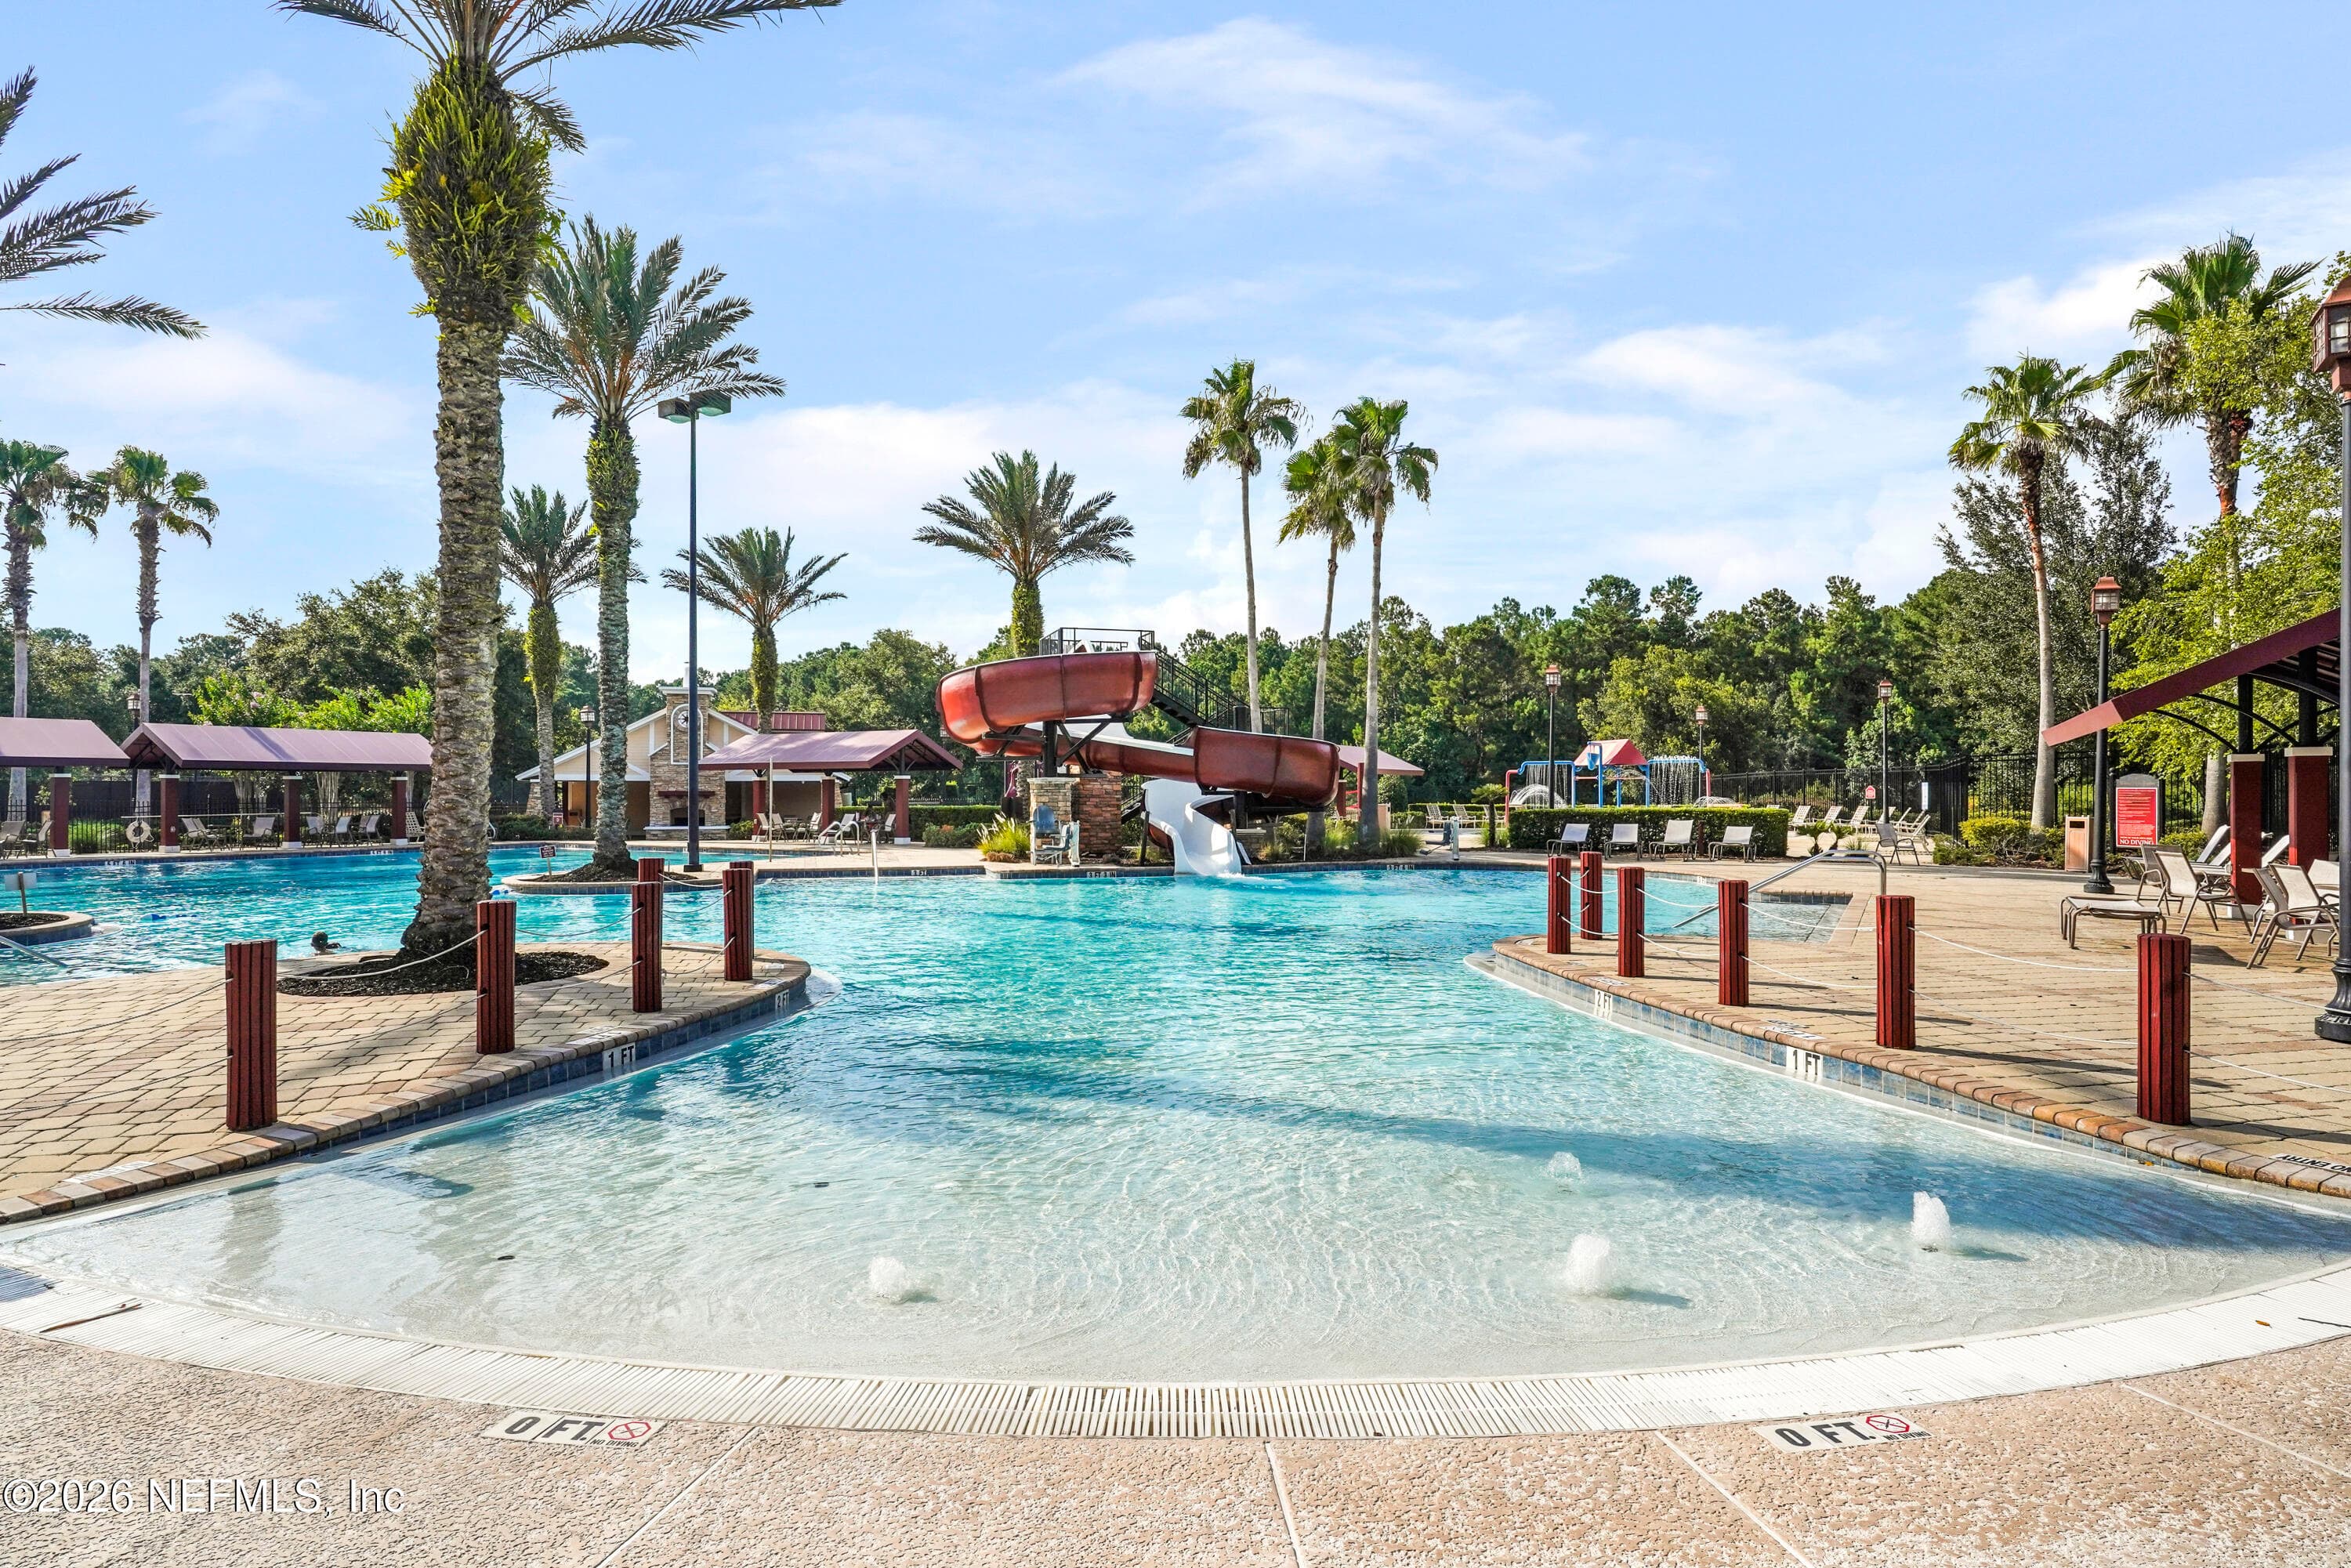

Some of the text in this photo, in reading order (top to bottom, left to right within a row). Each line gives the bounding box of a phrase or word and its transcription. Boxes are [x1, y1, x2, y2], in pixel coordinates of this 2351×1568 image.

[777, 991, 788, 1009] 2 FT
[1597, 991, 1611, 1009] 2 FT
[608, 1045, 635, 1067] 1 FT
[1793, 1049, 1820, 1076] 1 FT
[2276, 1155, 2331, 1168] ENTRY
[504, 1416, 541, 1435] 0
[1900, 1430, 1931, 1439] DIVING
[605, 1439, 639, 1448] DIVING
[1775, 1428, 1812, 1447] 0
